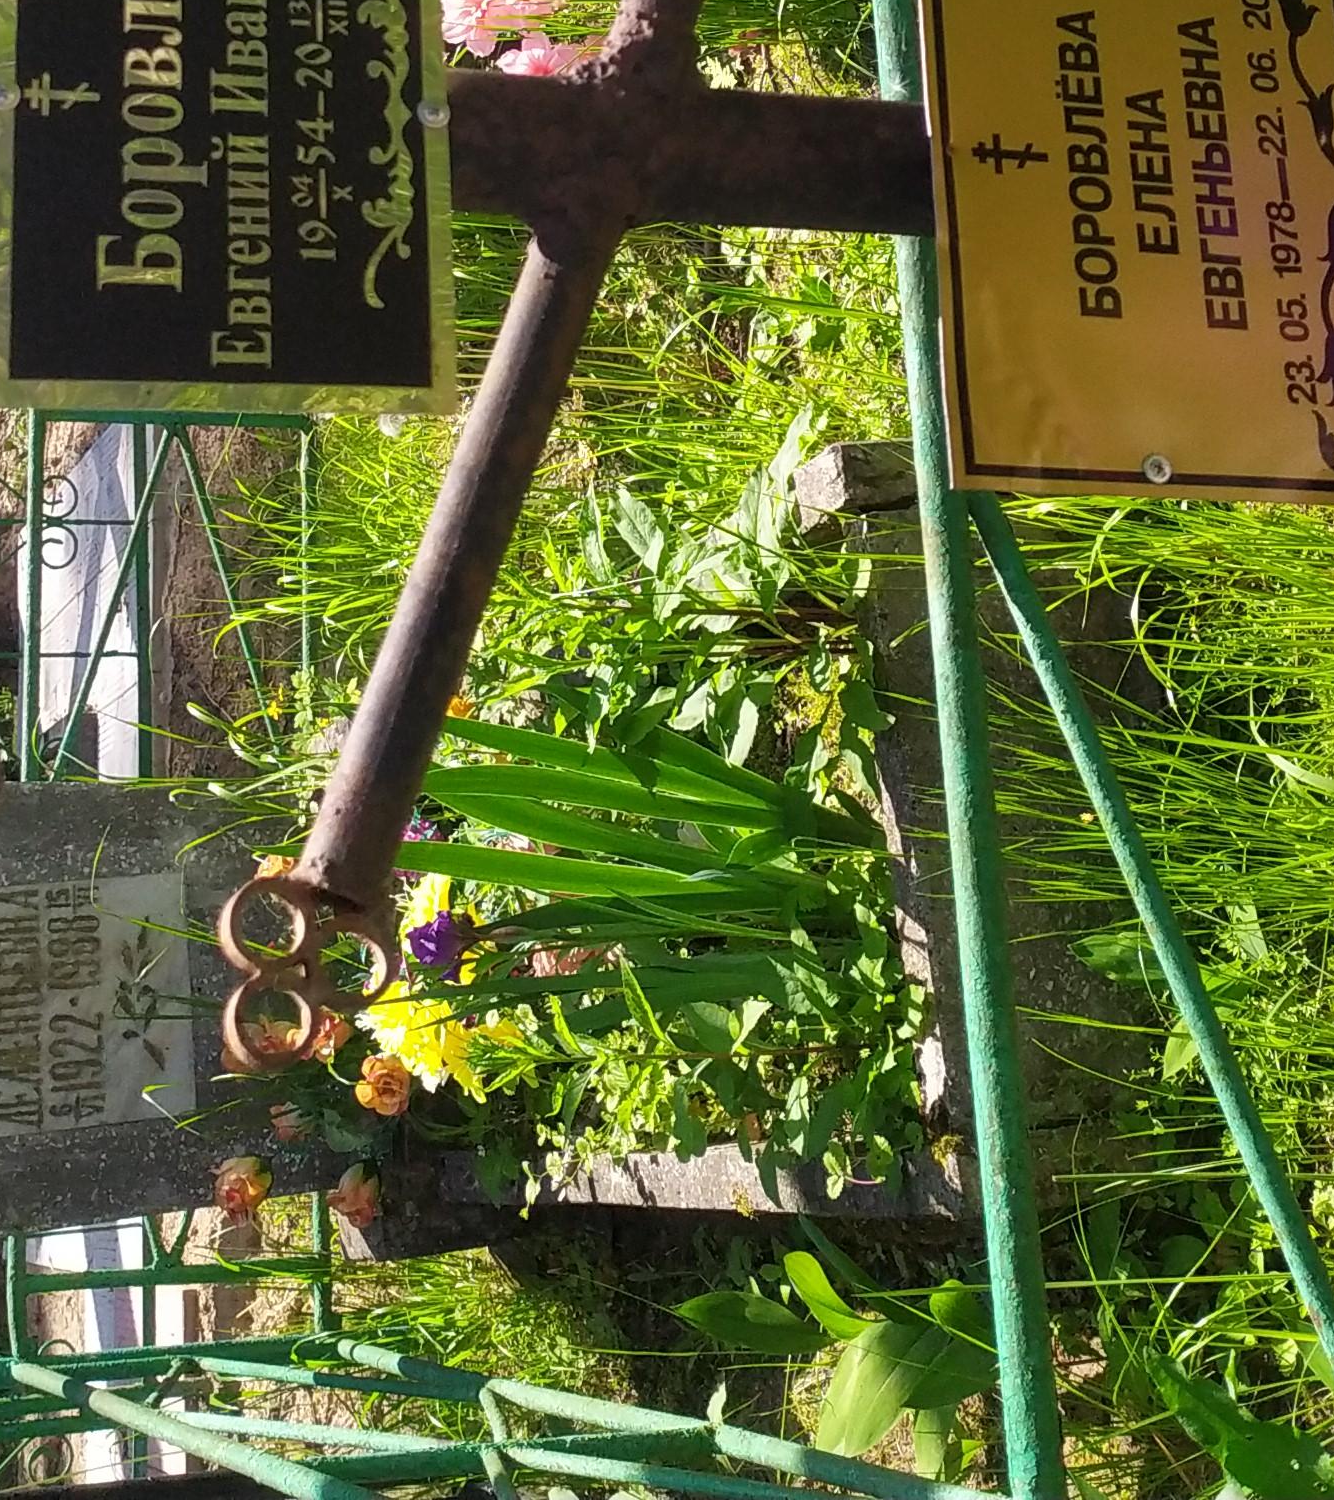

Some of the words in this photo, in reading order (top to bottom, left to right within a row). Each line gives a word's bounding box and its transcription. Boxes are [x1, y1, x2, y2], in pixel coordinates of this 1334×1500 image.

[1246, 48, 1280, 93] 06.
[1055, 10, 1123, 319] БОРОВЛЁВА
[1125, 89, 1179, 255] ЕЛЕНА
[1177, 17, 1248, 330] ЕВГЕНЬЕВНА
[210, 133, 272, 369] Евгений
[1277, 293, 1310, 342] 05.
[1283, 355, 1318, 405] 23.
